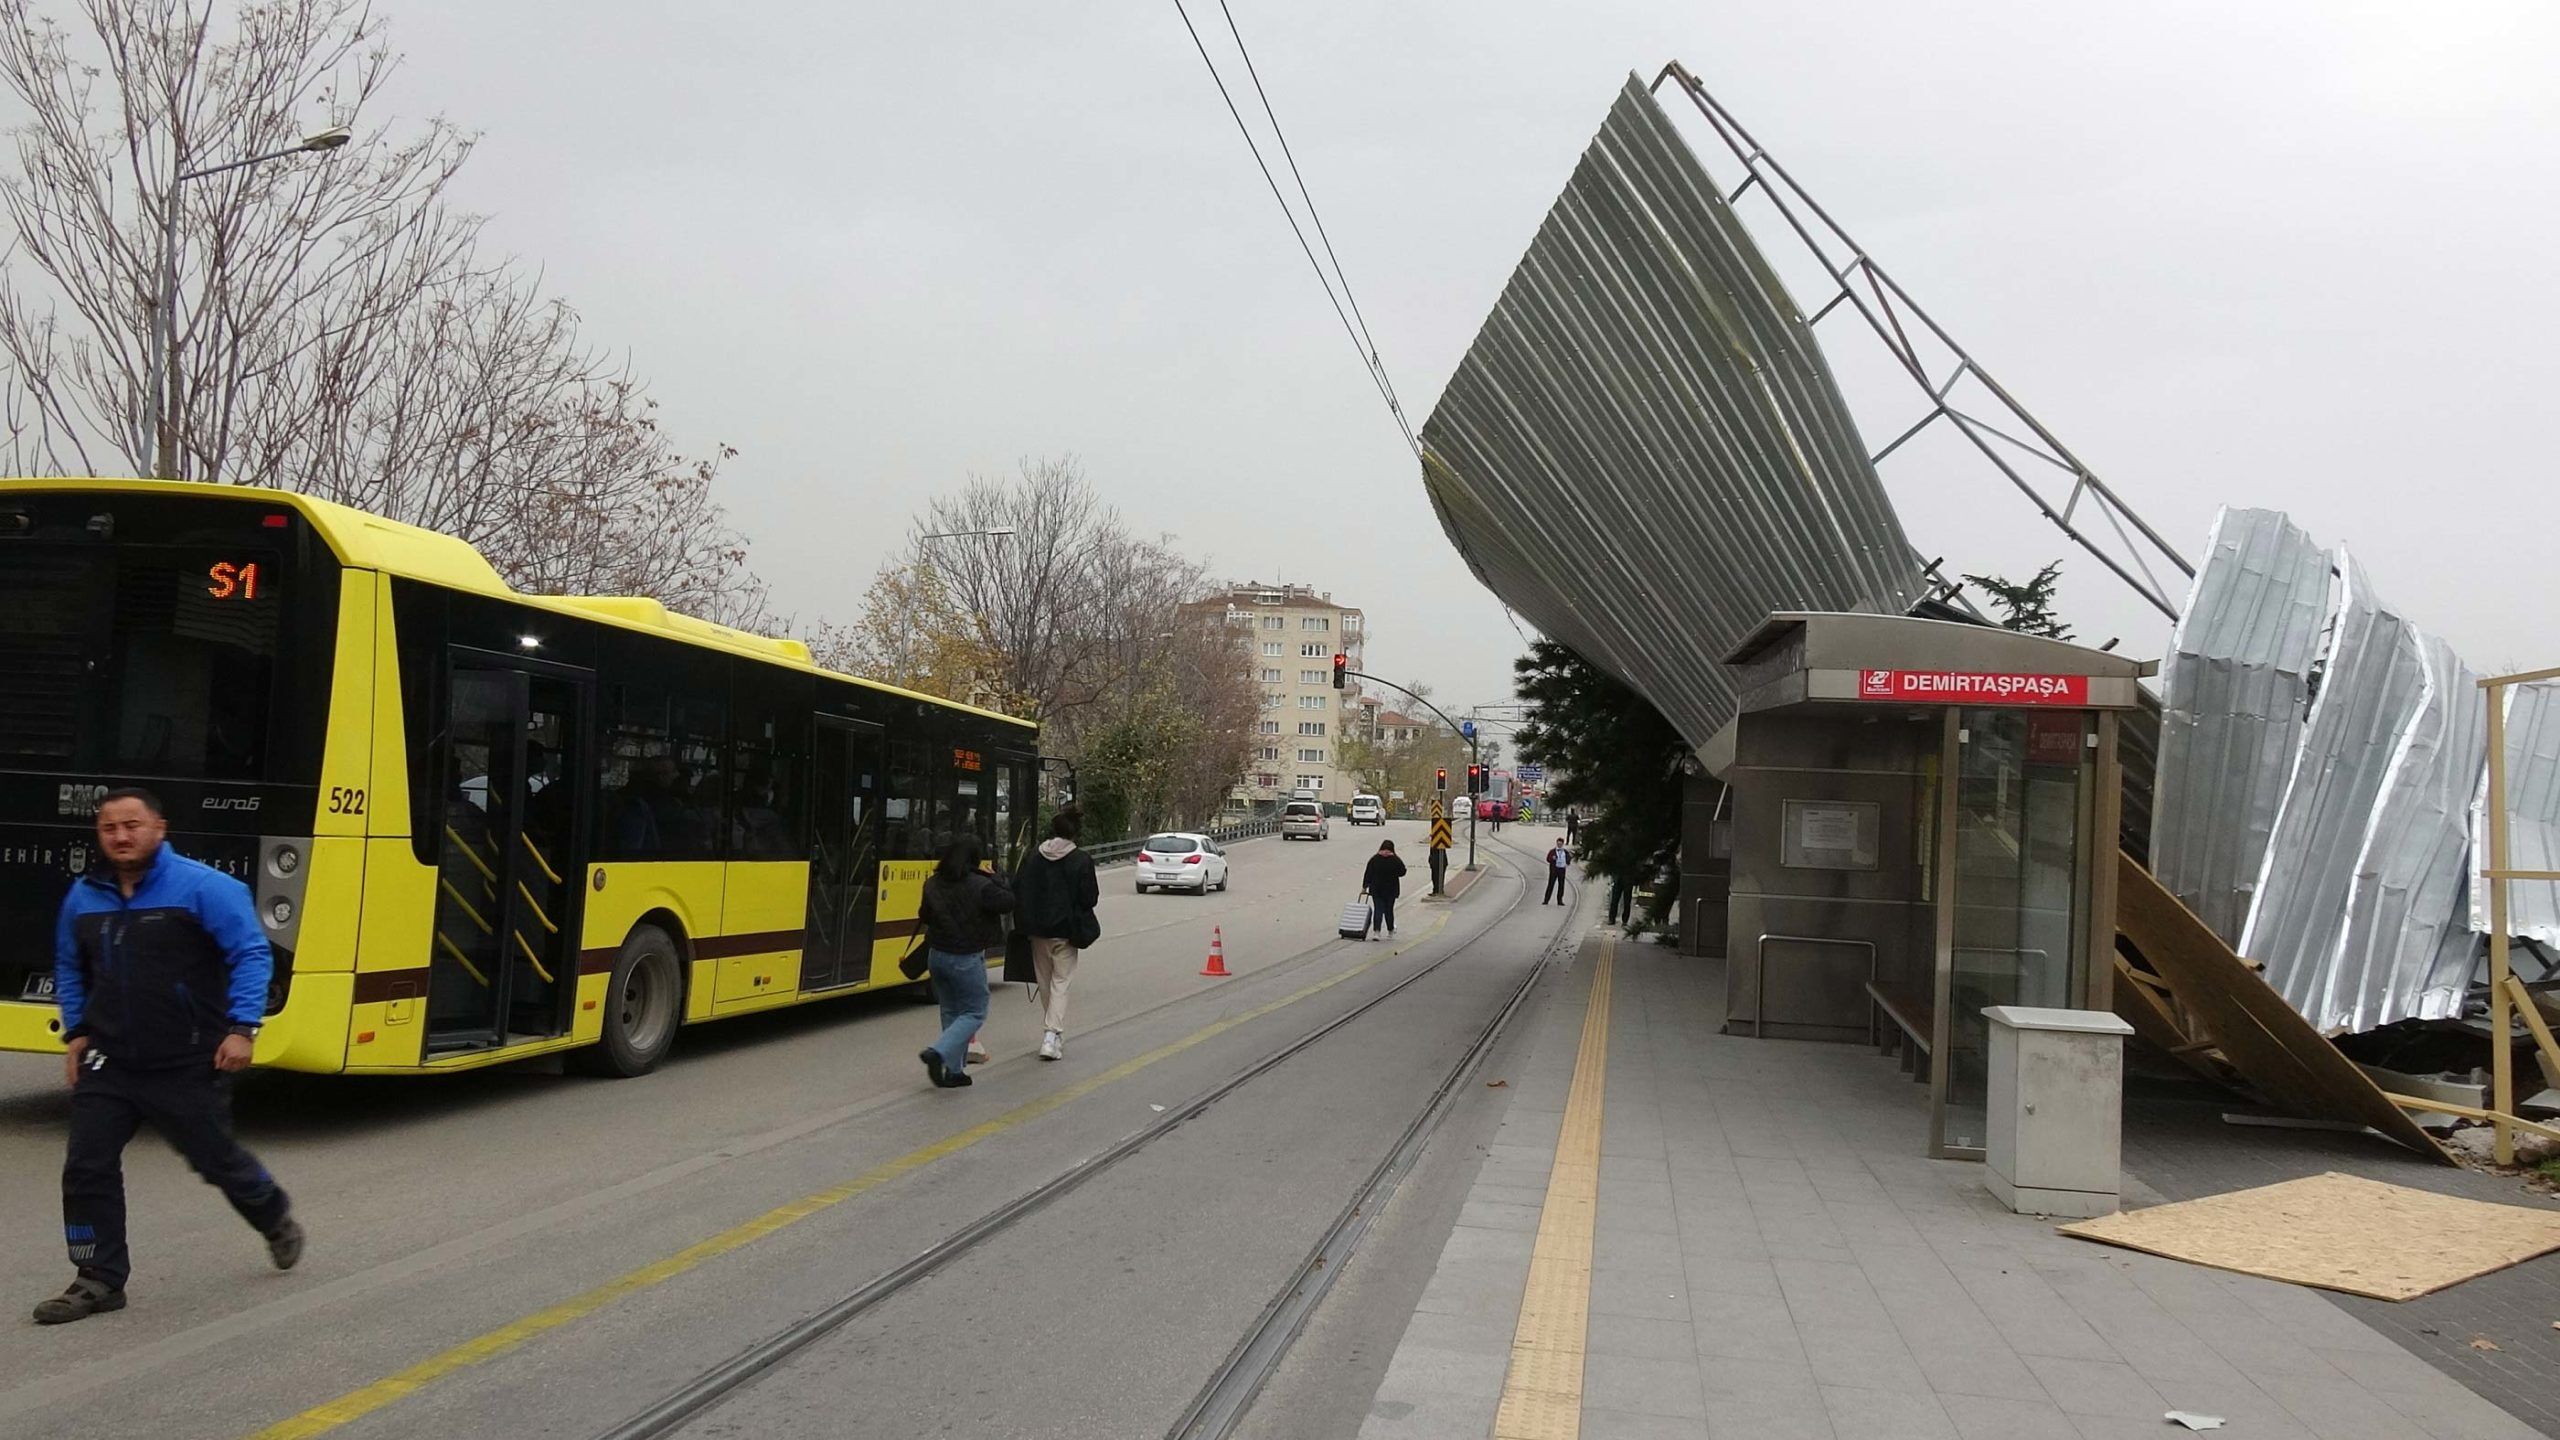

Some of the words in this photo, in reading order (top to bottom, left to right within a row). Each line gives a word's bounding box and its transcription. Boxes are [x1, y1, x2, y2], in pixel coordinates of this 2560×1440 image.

[207, 562, 257, 599] S1
[1903, 672, 2069, 697] DEMİRTAŞPAŞA
[202, 796, 261, 811] euro6
[328, 787, 365, 815] 522
